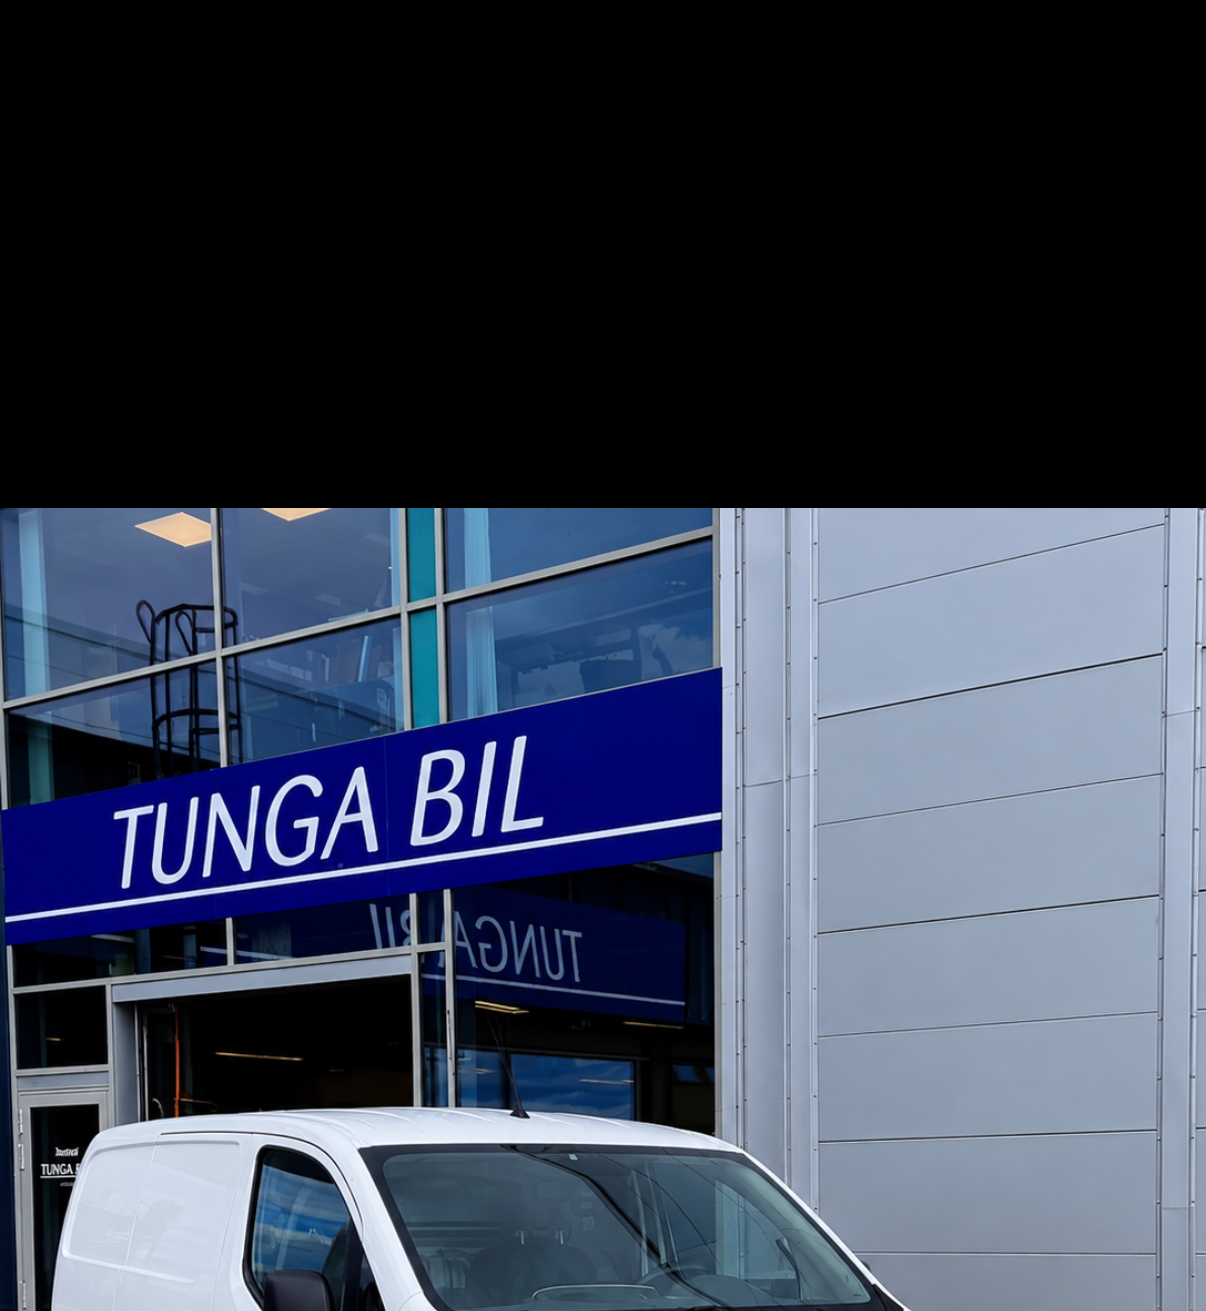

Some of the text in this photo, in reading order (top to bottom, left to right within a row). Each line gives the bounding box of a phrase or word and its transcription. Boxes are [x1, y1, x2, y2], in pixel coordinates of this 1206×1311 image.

[113, 735, 544, 889] TUNGA BIL
[40, 1163, 74, 1176] TUNGA
